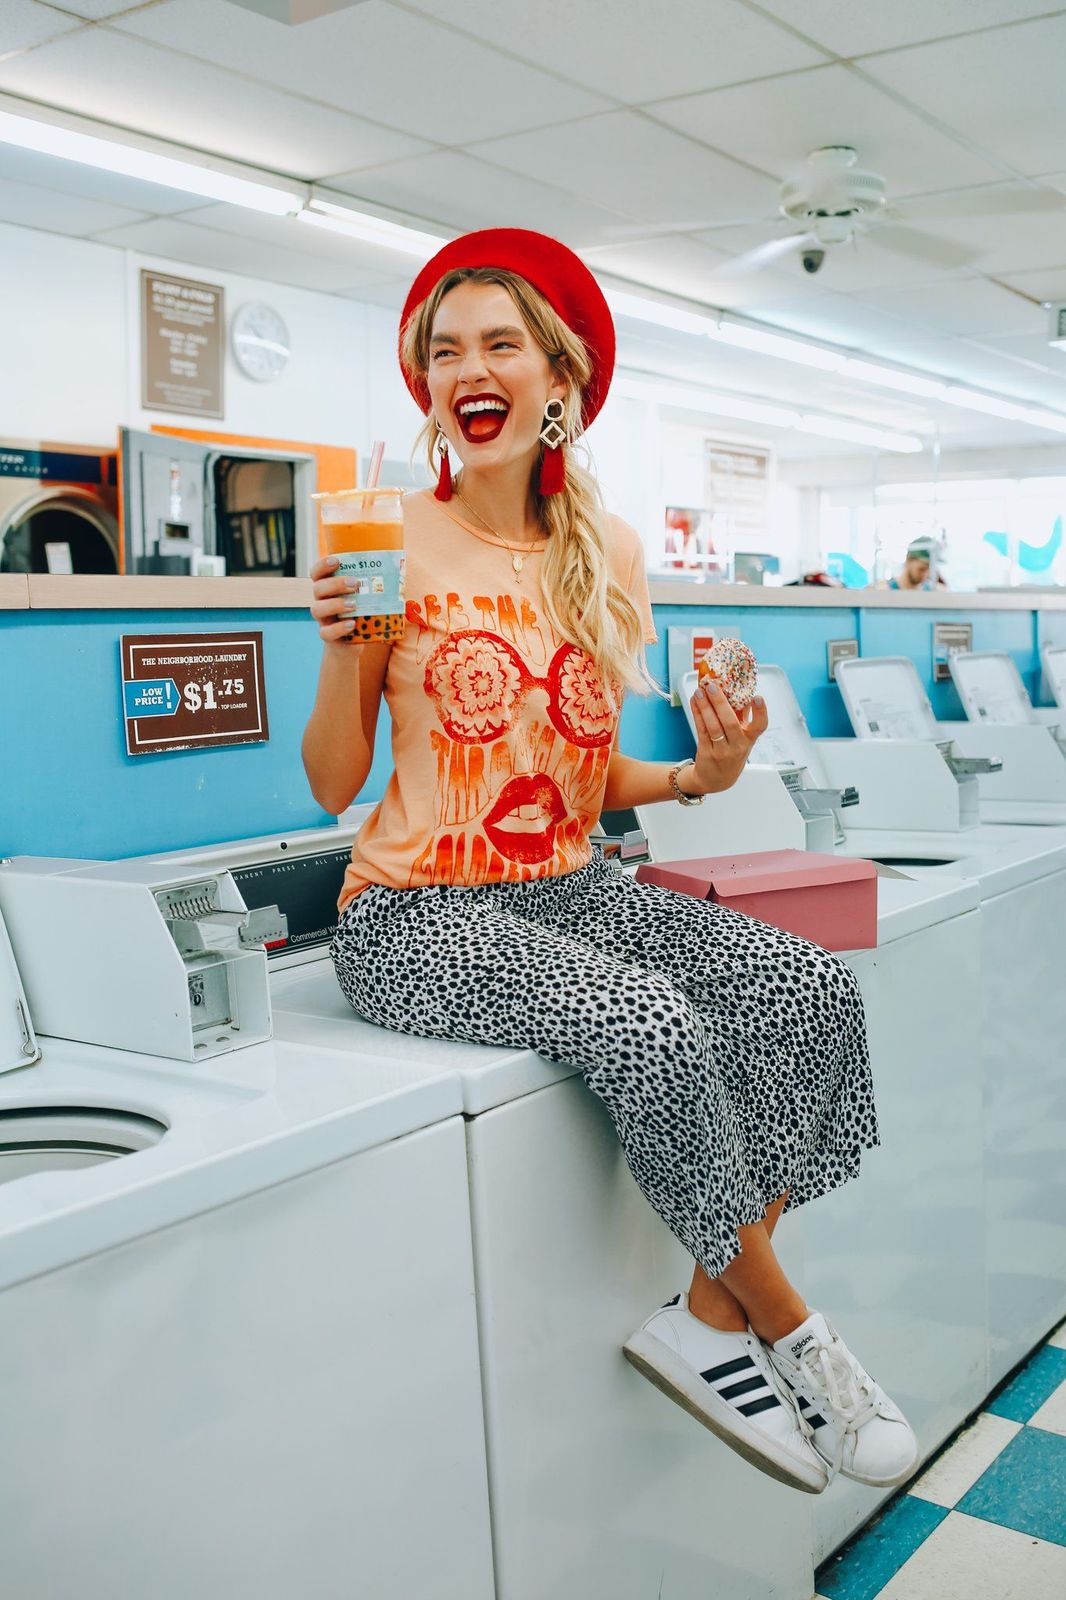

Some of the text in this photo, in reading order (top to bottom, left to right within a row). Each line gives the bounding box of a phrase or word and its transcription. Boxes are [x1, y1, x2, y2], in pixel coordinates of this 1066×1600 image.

[339, 560, 382, 571] Save $1.00
[473, 593, 547, 667] THE
[141, 653, 248, 666] THE NEIGHBORHOOD LAUNDRY
[141, 687, 163, 697] LOW
[183, 678, 245, 714] $1.75
[272, 864, 296, 874] PRESS
[315, 858, 328, 866] ALL
[290, 927, 327, 943] Commercial
[791, 1334, 815, 1353] adidas
